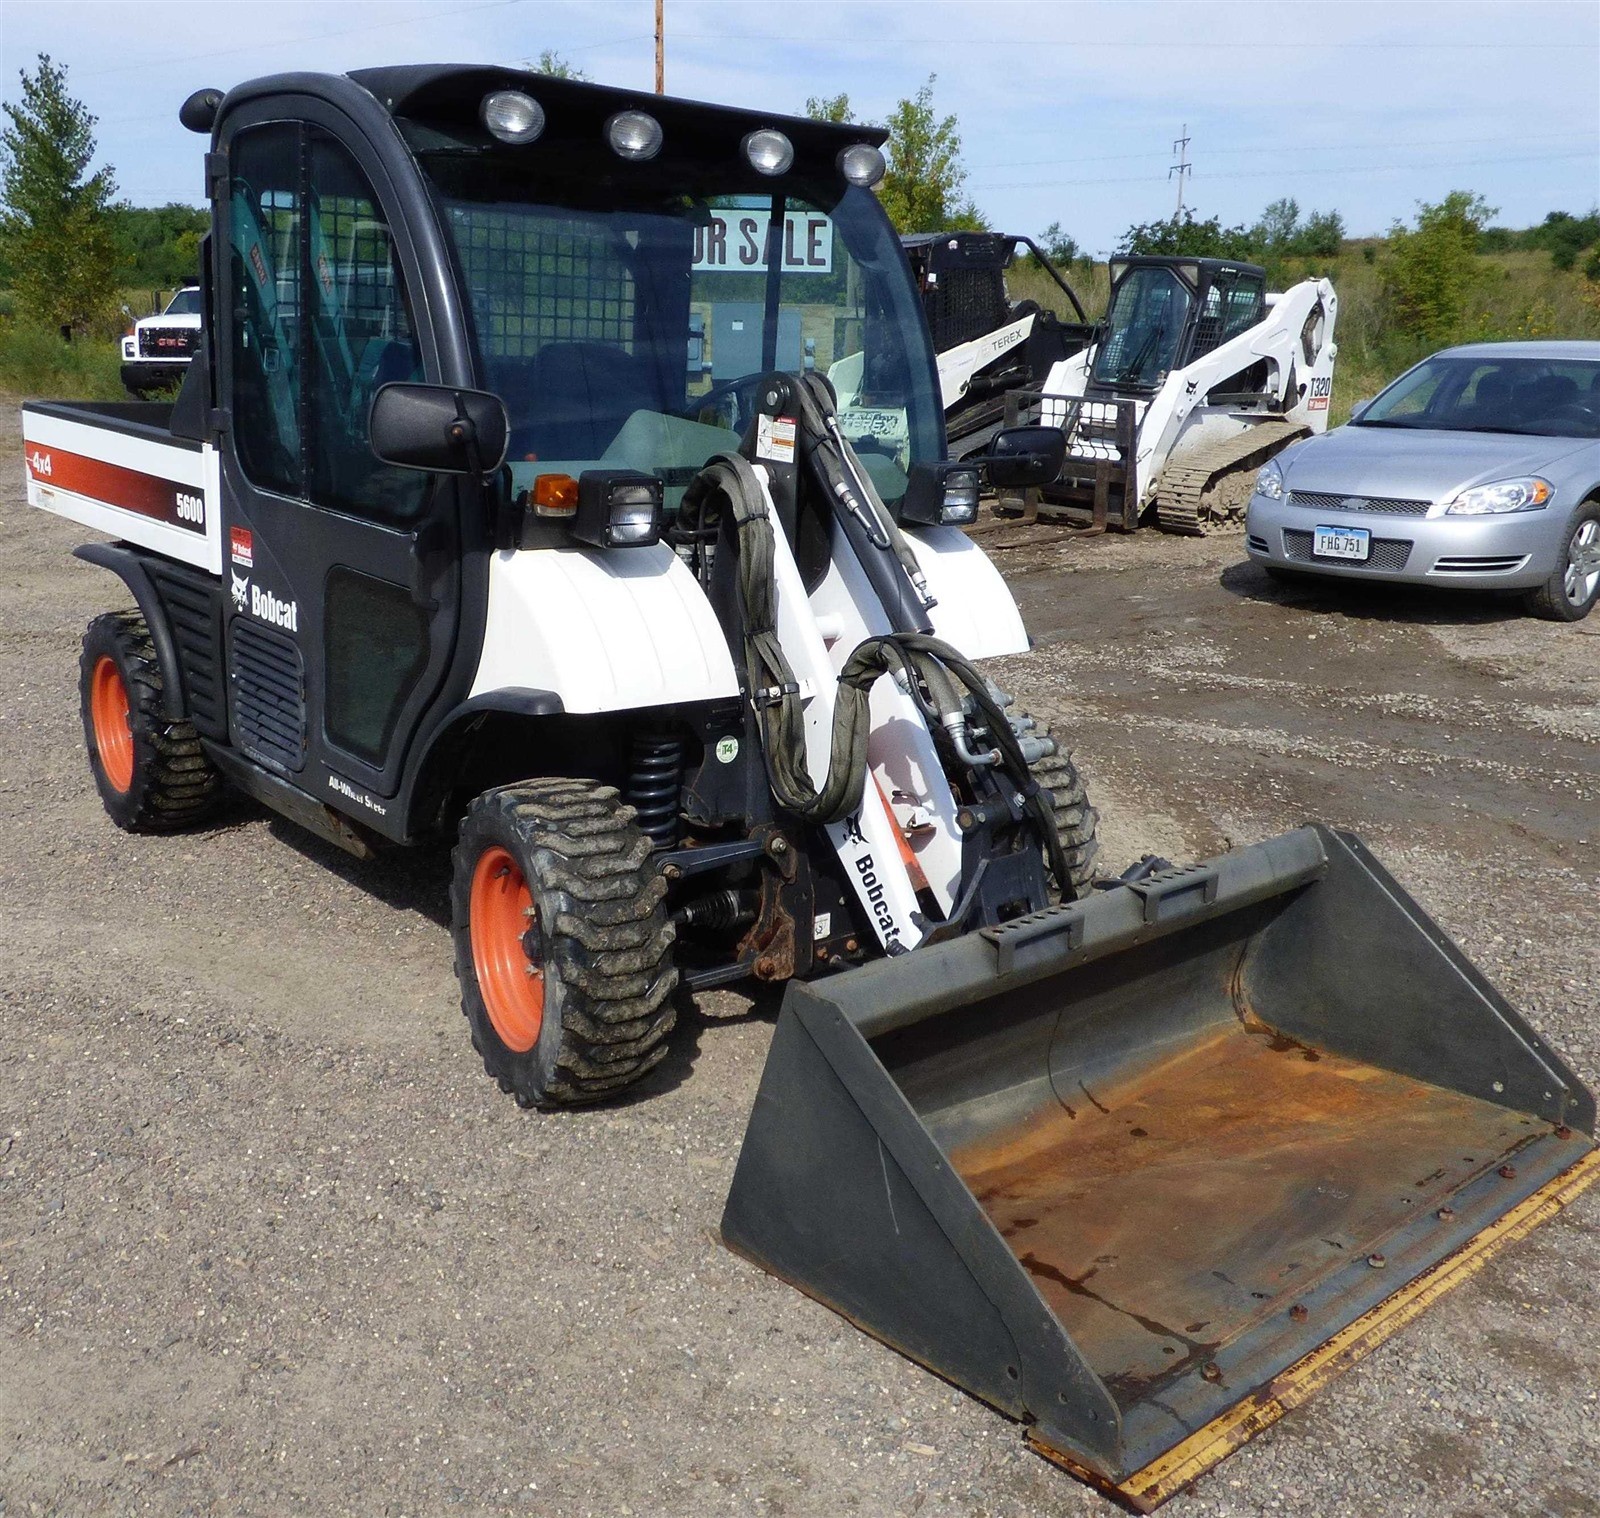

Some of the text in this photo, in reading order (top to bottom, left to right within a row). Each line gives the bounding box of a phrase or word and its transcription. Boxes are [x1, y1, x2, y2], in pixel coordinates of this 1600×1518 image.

[992, 329, 1022, 351] TEREX
[1310, 377, 1331, 397] T320
[32, 451, 52, 476] 4x4
[176, 492, 204, 524] 5600
[1320, 535, 1361, 553] FHG 751
[251, 584, 298, 633] Bobcat
[722, 743, 733, 755] T4
[855, 853, 901, 942] Bobcat
